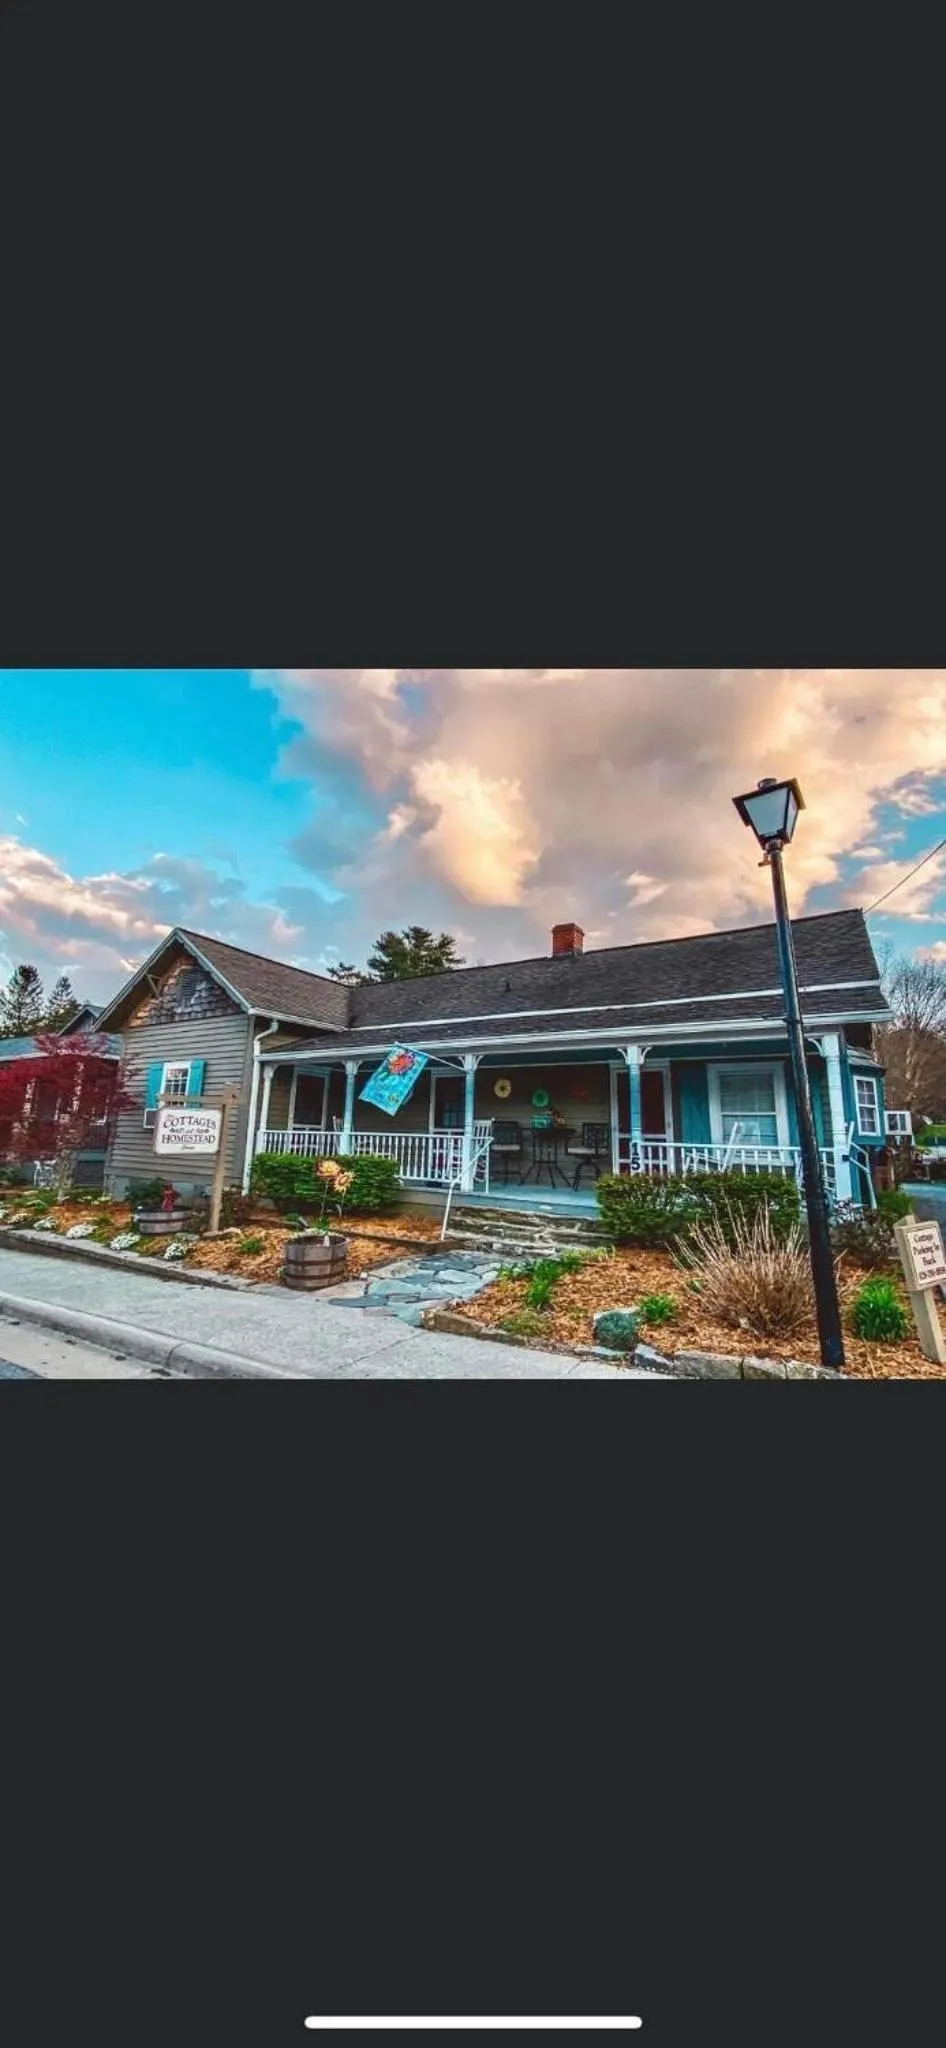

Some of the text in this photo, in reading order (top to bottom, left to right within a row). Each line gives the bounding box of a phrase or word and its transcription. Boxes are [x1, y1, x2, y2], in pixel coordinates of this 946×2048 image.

[163, 1116, 217, 1129] COTTAGES
[162, 1134, 216, 1144] HOMESTEAD
[631, 1142, 641, 1171] 15
